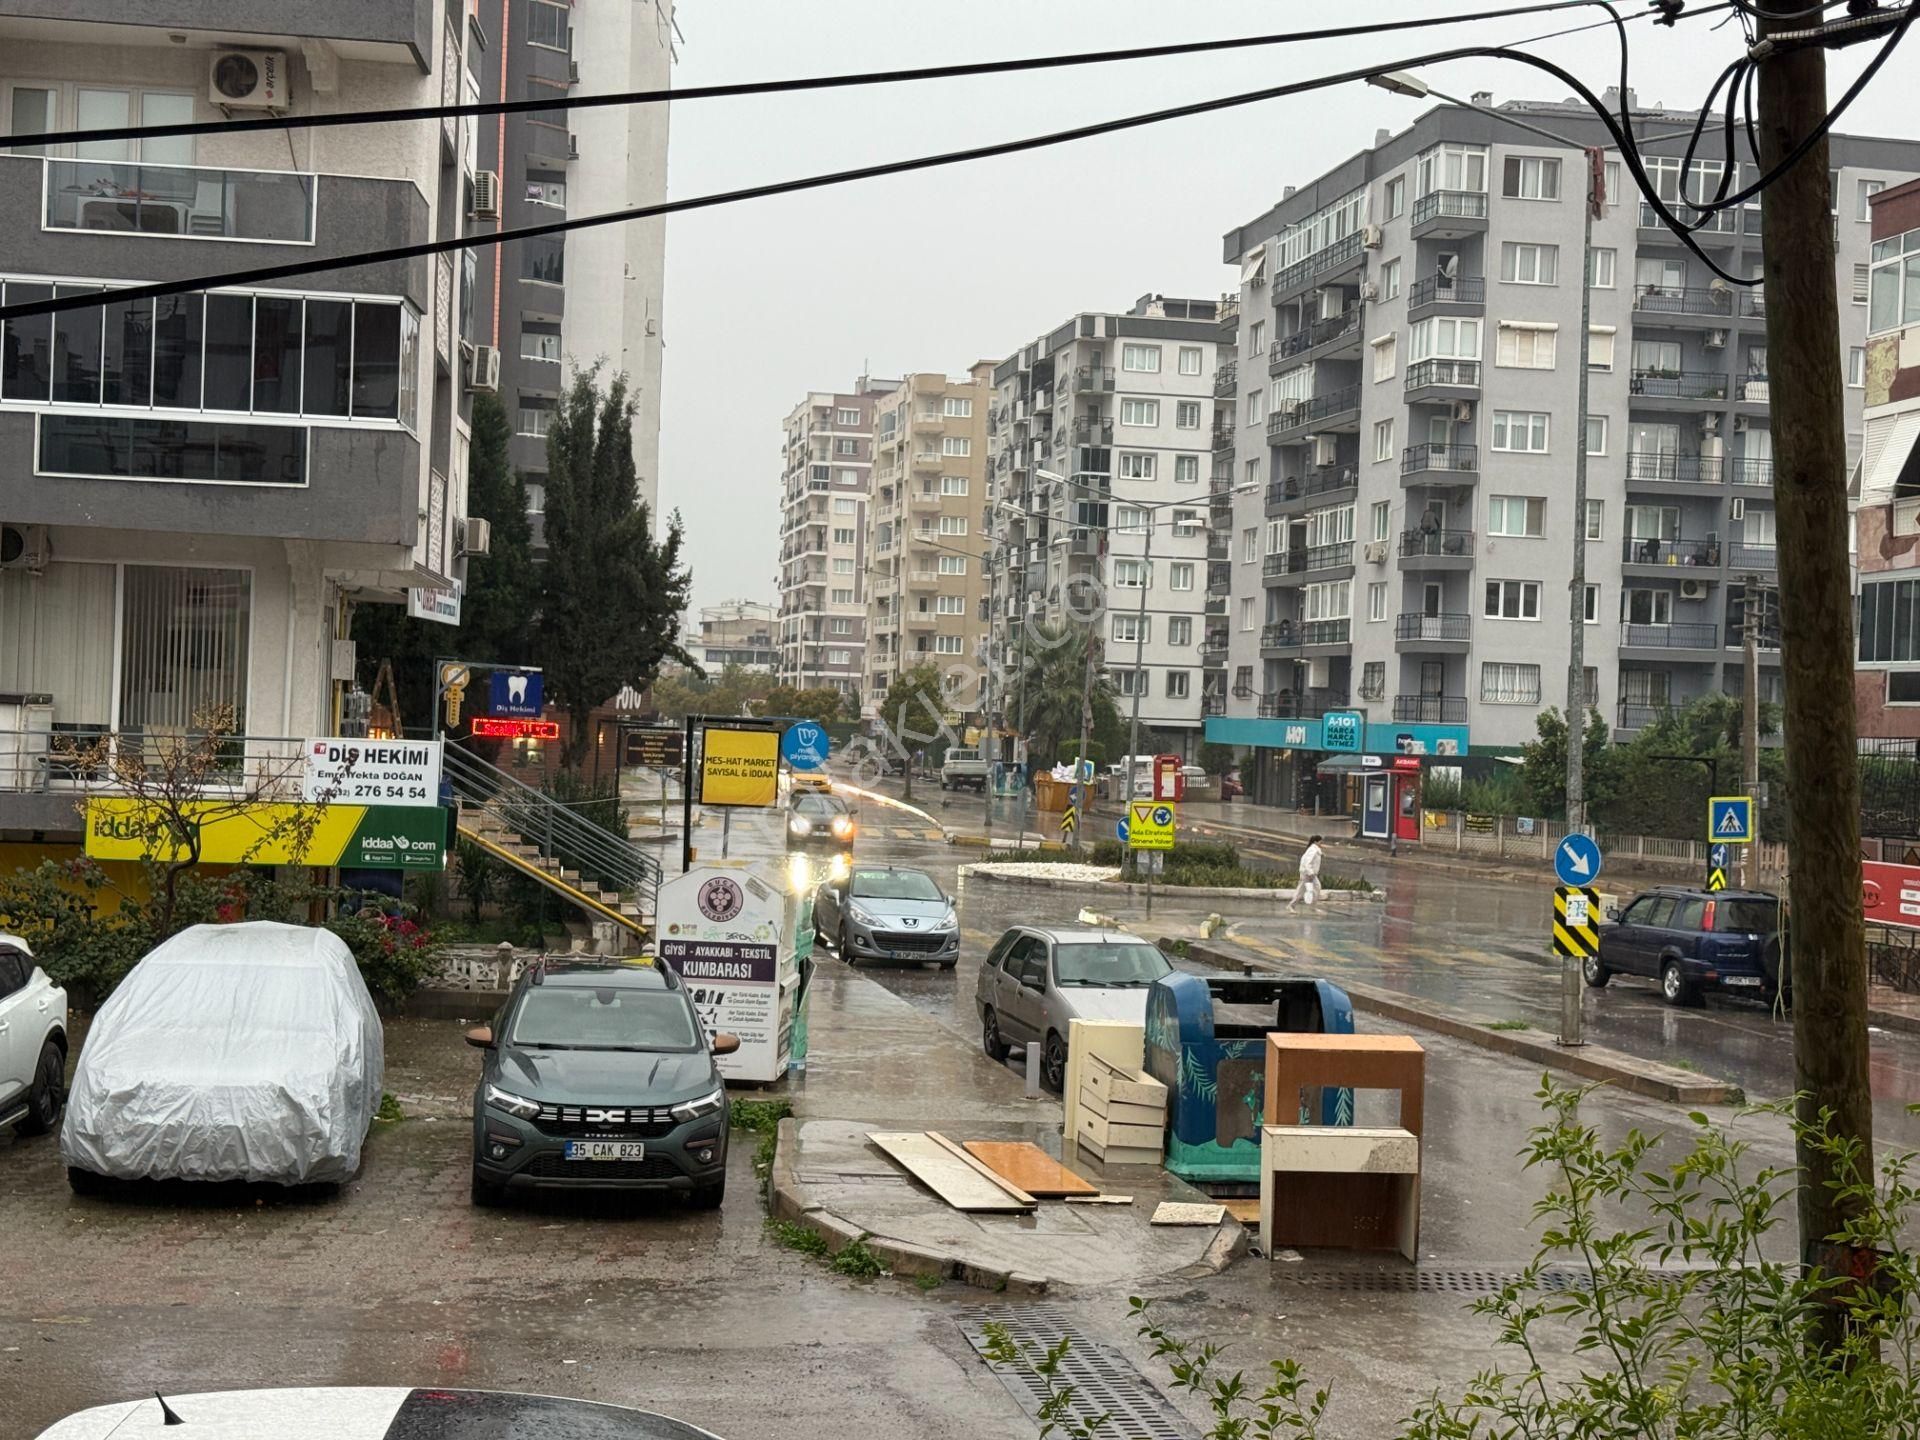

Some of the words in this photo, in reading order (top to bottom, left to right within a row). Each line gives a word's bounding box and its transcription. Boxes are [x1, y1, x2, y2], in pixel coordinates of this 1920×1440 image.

[264, 55, 276, 89] arçelik
[510, 704, 536, 713] Hekimi
[1327, 726, 1355, 734] HARCA
[1327, 733, 1355, 741] HARCA
[364, 746, 429, 766] HEKİMİ
[789, 753, 821, 762] piyango
[743, 758, 777, 767] MARKET
[383, 771, 423, 781] DOĞAN
[706, 767, 740, 777] SAYISAL
[741, 769, 748, 777] &
[355, 785, 382, 797] 276
[386, 786, 404, 798] 54
[408, 787, 426, 799] 54
[362, 836, 394, 849] iddaa
[664, 943, 686, 956] GİYSİ
[695, 945, 733, 958] AYAKKABI
[740, 947, 772, 960] TEKSTİL
[682, 960, 752, 979] KUMBARASI
[571, 1143, 586, 1156] 35
[593, 1143, 614, 1157] CAK
[620, 1144, 641, 1157] 823
